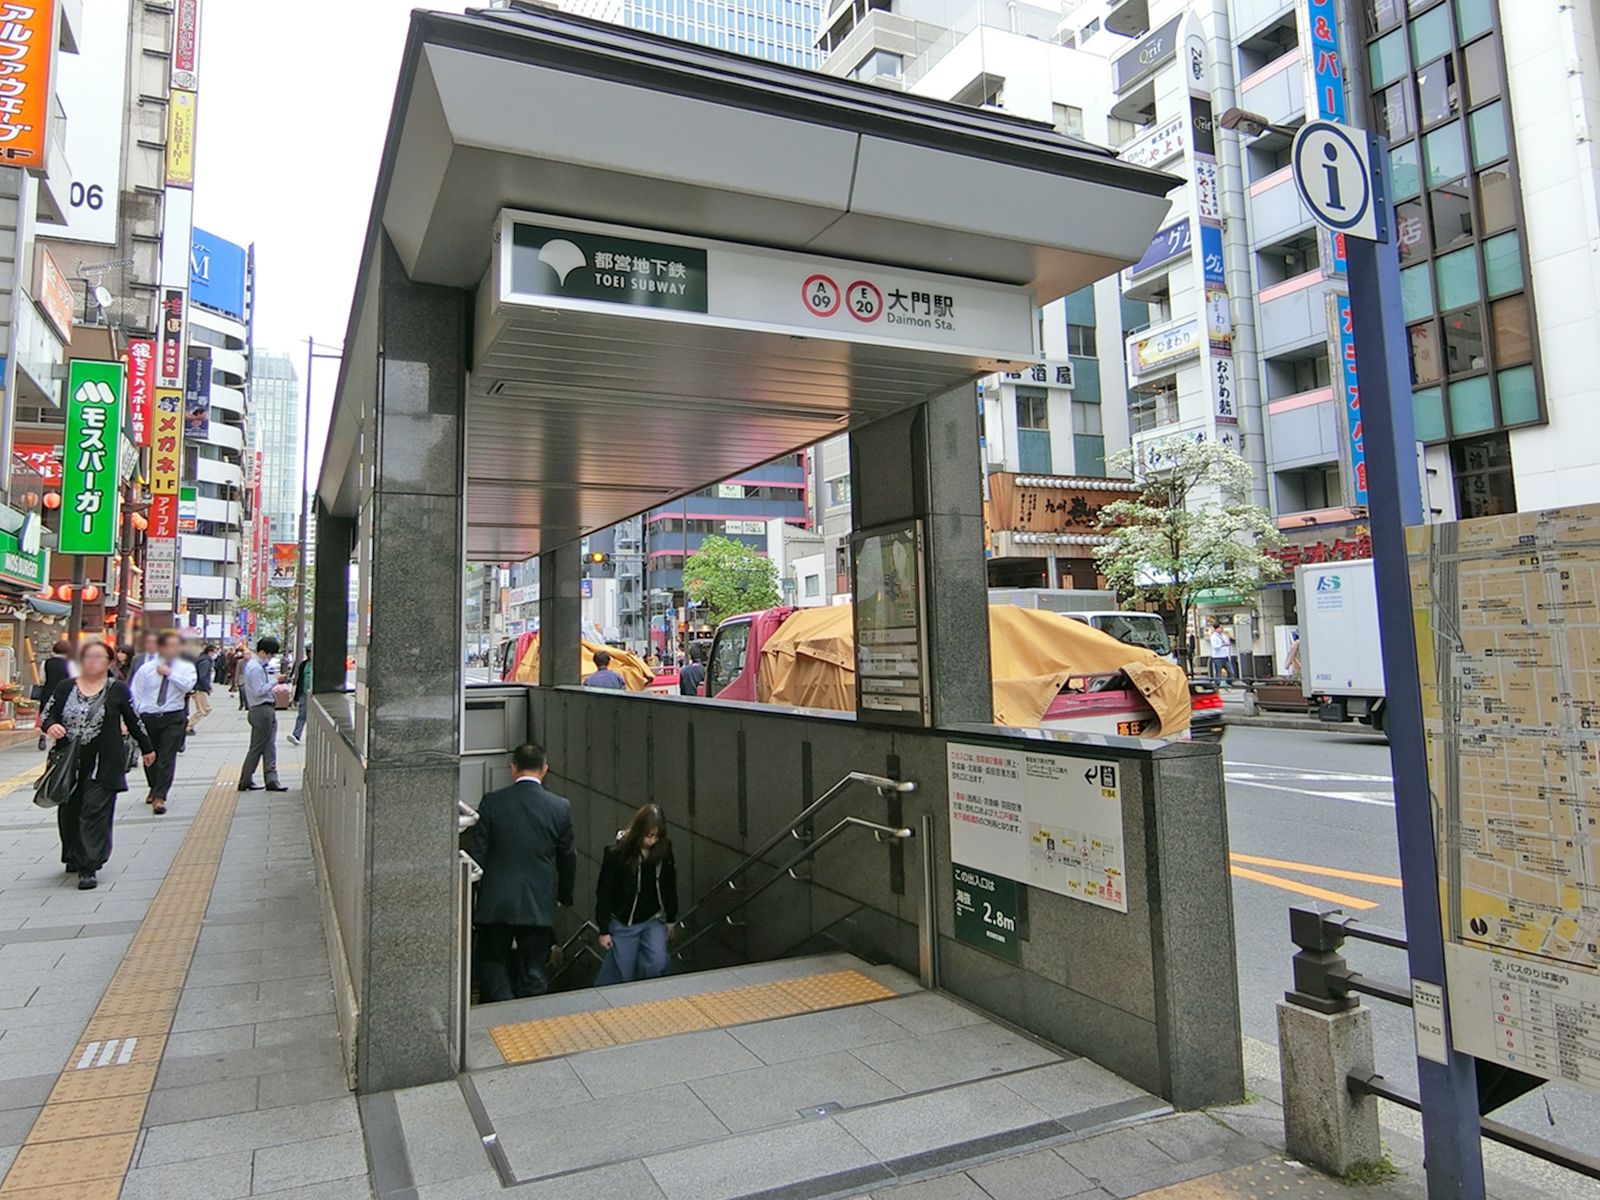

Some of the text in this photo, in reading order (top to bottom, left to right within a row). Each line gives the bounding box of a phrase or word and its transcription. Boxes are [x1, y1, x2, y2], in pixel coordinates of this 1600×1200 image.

[173, 111, 184, 166] LUMBINI
[594, 251, 687, 280] 都営地下鉄
[595, 272, 687, 296] TOEI SUBWAY
[816, 281, 827, 294] A
[861, 288, 868, 299] E
[812, 294, 831, 309] 09
[856, 300, 874, 314] 20
[887, 288, 955, 319] 大門駅
[887, 312, 956, 331] Daimon Sta.
[156, 416, 177, 475] メガネ
[76, 406, 107, 534] モスバーガー
[155, 479, 176, 490] 1F
[1045, 498, 1067, 513] 九州
[156, 496, 170, 537] アイフル
[273, 565, 296, 578] 大門
[982, 902, 1015, 932] 2.8m
[1506, 963, 1570, 986] バスのりば案内
[1506, 973, 1517, 981] Bus
[1518, 975, 1530, 984] Stop
[1530, 978, 1560, 991] Information
[1418, 1022, 1442, 1036] No.23
